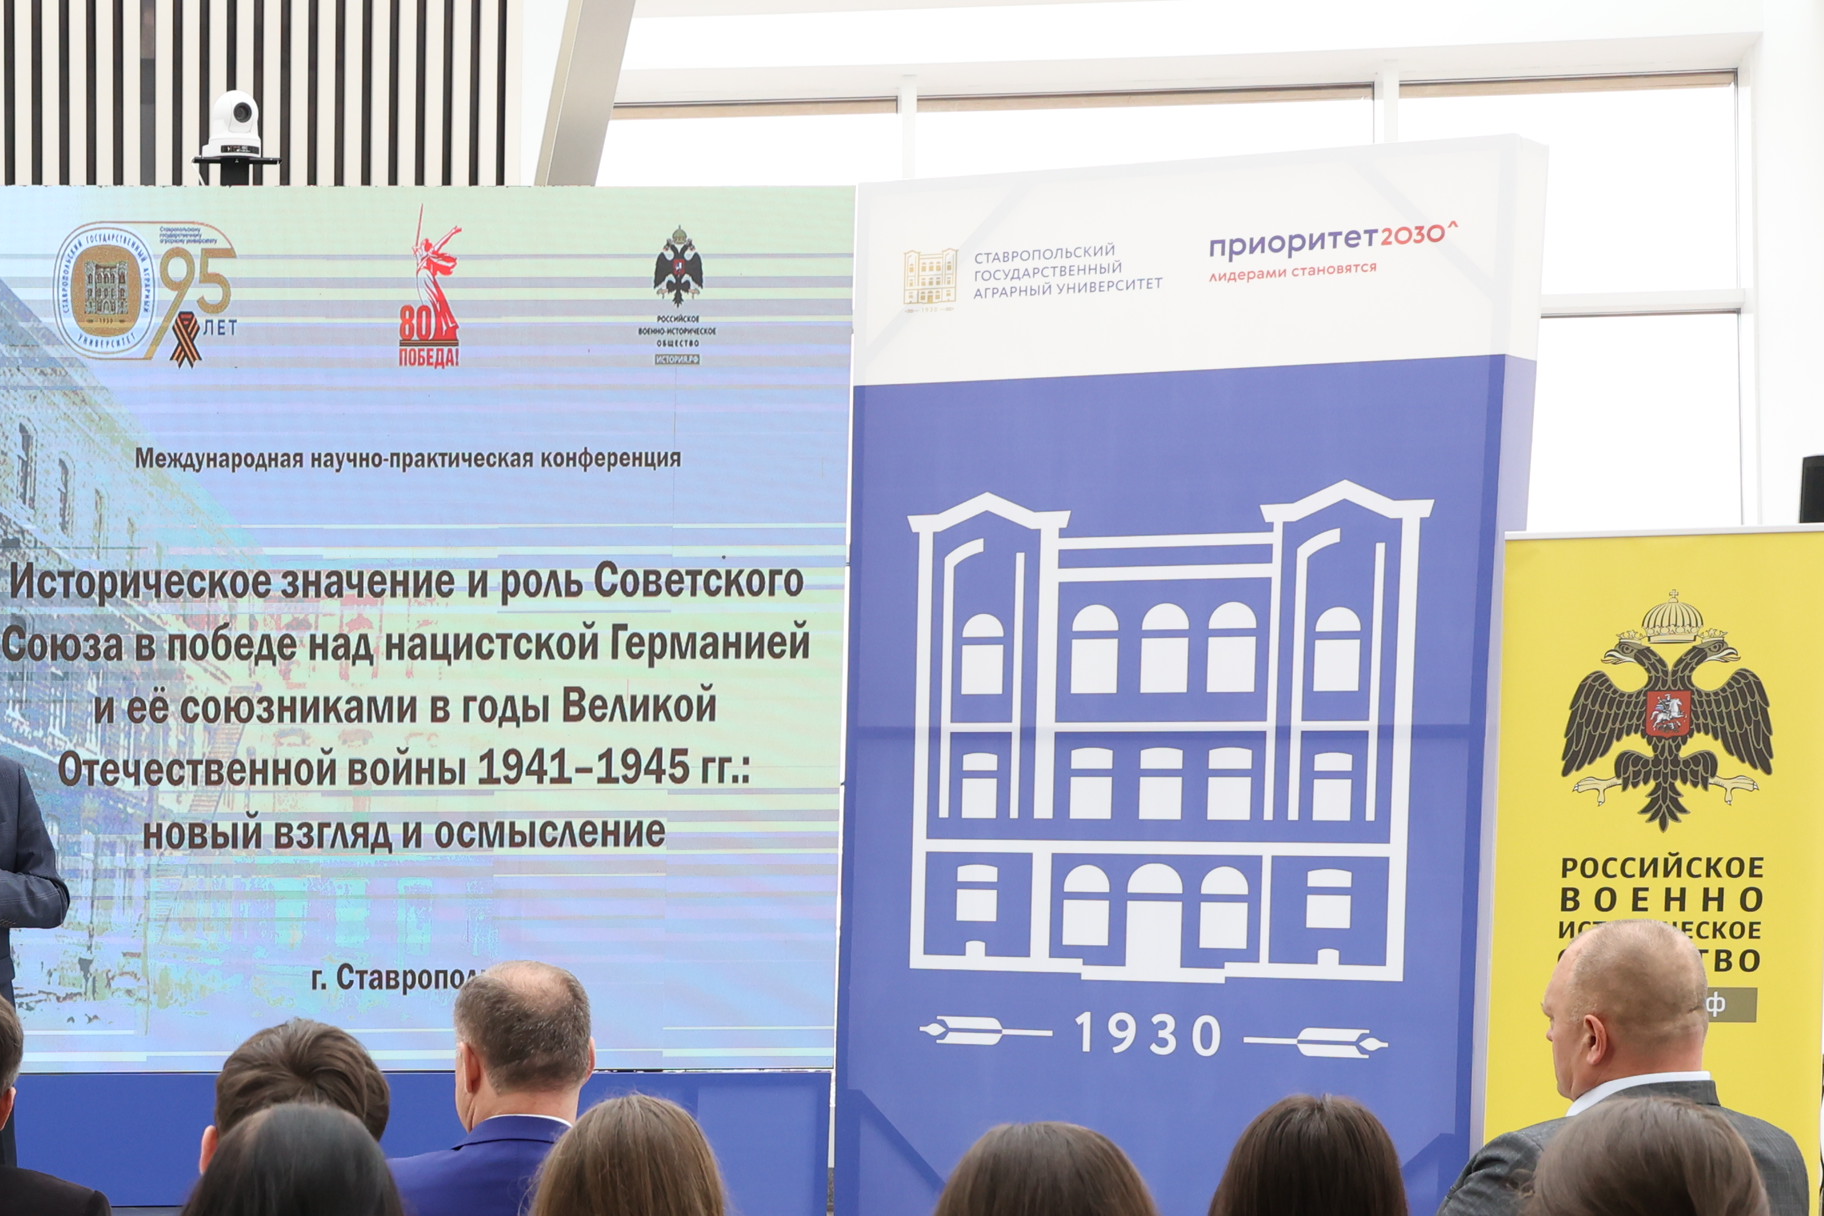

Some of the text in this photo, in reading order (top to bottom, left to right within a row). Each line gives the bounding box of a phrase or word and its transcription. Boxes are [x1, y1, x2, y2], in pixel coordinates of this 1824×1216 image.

[974, 242, 1116, 265] СТАВРОПОЛЬСКИЙ
[974, 260, 1122, 282] ГОСУДАРСТВЕННЫЙ
[1209, 262, 1378, 284] лидерами становятся
[973, 277, 1164, 300] АГРАРНЫЙ УНИВЕРСИТЕТ
[143, 247, 237, 360] 95
[203, 320, 238, 336] ЛЕТ
[399, 304, 432, 341] 80
[656, 314, 700, 323] РОССИЙСКОЕ
[656, 339, 700, 348] ОБЩЕСТВО
[399, 348, 460, 369] ПОБЕДА!
[135, 447, 681, 473] Международная научно-практическая конференция
[10, 560, 804, 606] Историческое значение и роль Советского
[1, 620, 810, 667] Союза в победе над нацистской Германией
[94, 683, 716, 728] и её союзниками в годы Великой
[58, 747, 336, 787] Отечественной
[348, 747, 466, 786] войны
[702, 756, 750, 784] гг.:
[143, 810, 666, 855] новый взгляд и осмысление
[1561, 851, 1764, 879] РОССИЙСКОЕ
[1560, 887, 1764, 912] ВОЕННО
[311, 970, 327, 990] г.
[1074, 1011, 1222, 1057] 1930
